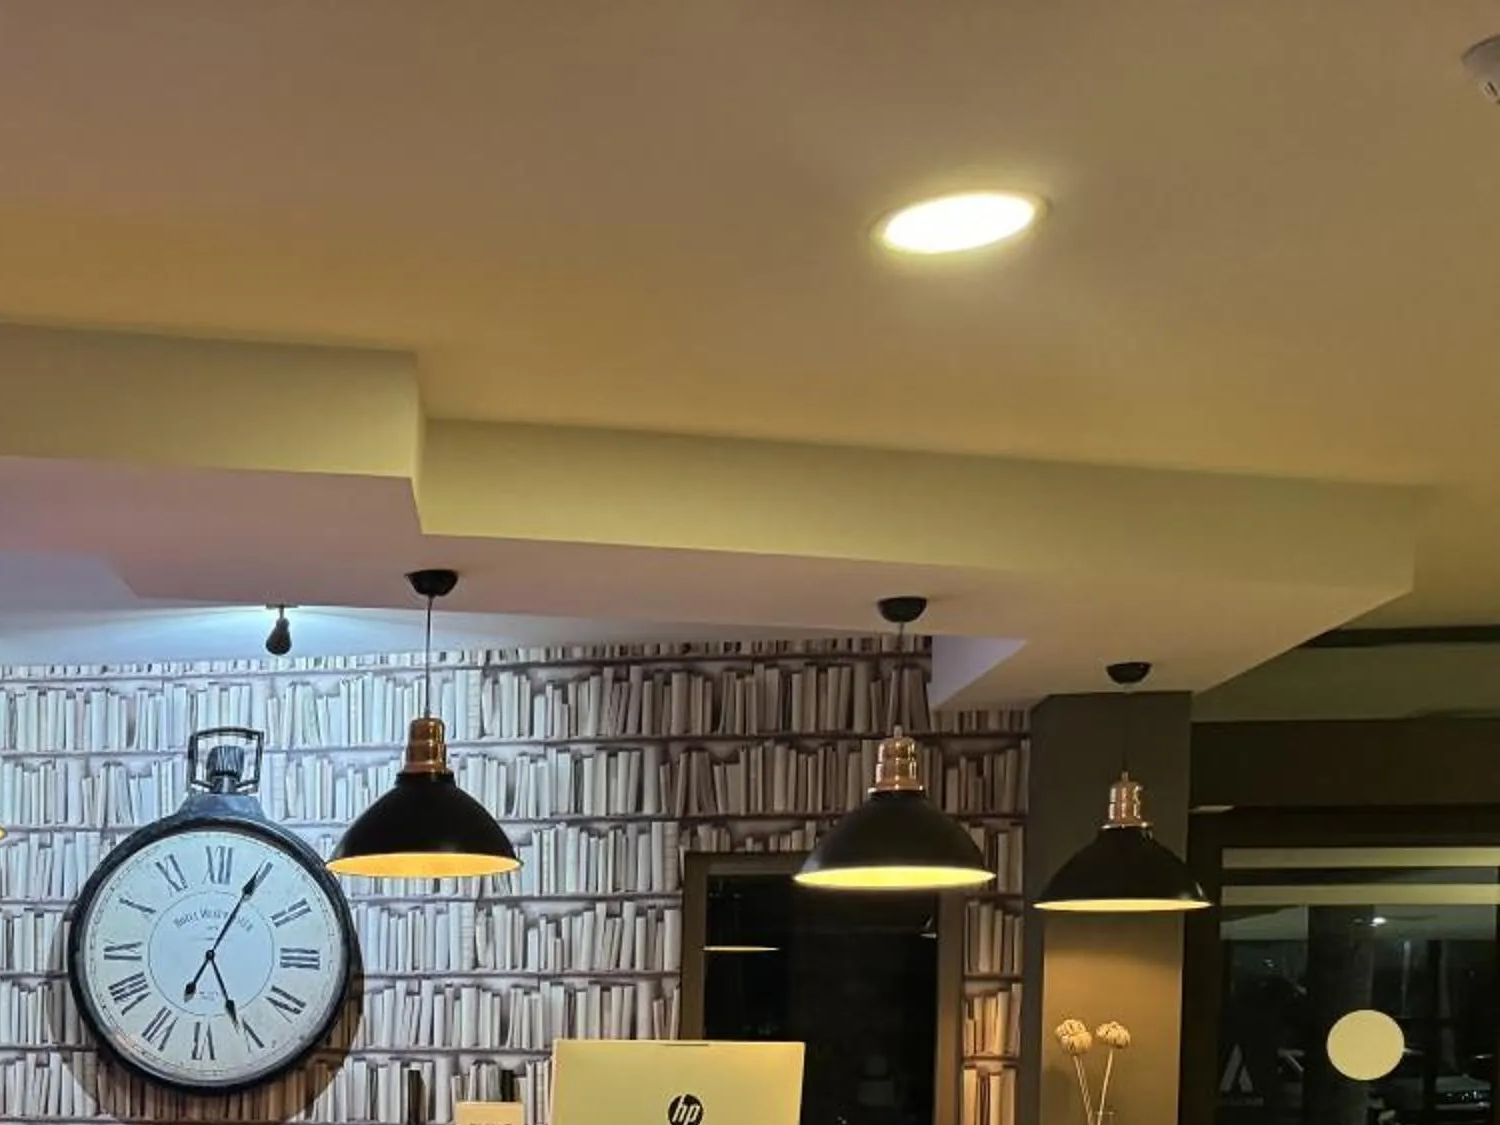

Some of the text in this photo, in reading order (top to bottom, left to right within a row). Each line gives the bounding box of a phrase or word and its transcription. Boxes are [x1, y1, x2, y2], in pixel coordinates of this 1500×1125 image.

[155, 854, 188, 893] XI
[203, 846, 233, 884] XII
[270, 899, 312, 928] II
[280, 948, 320, 970] III
